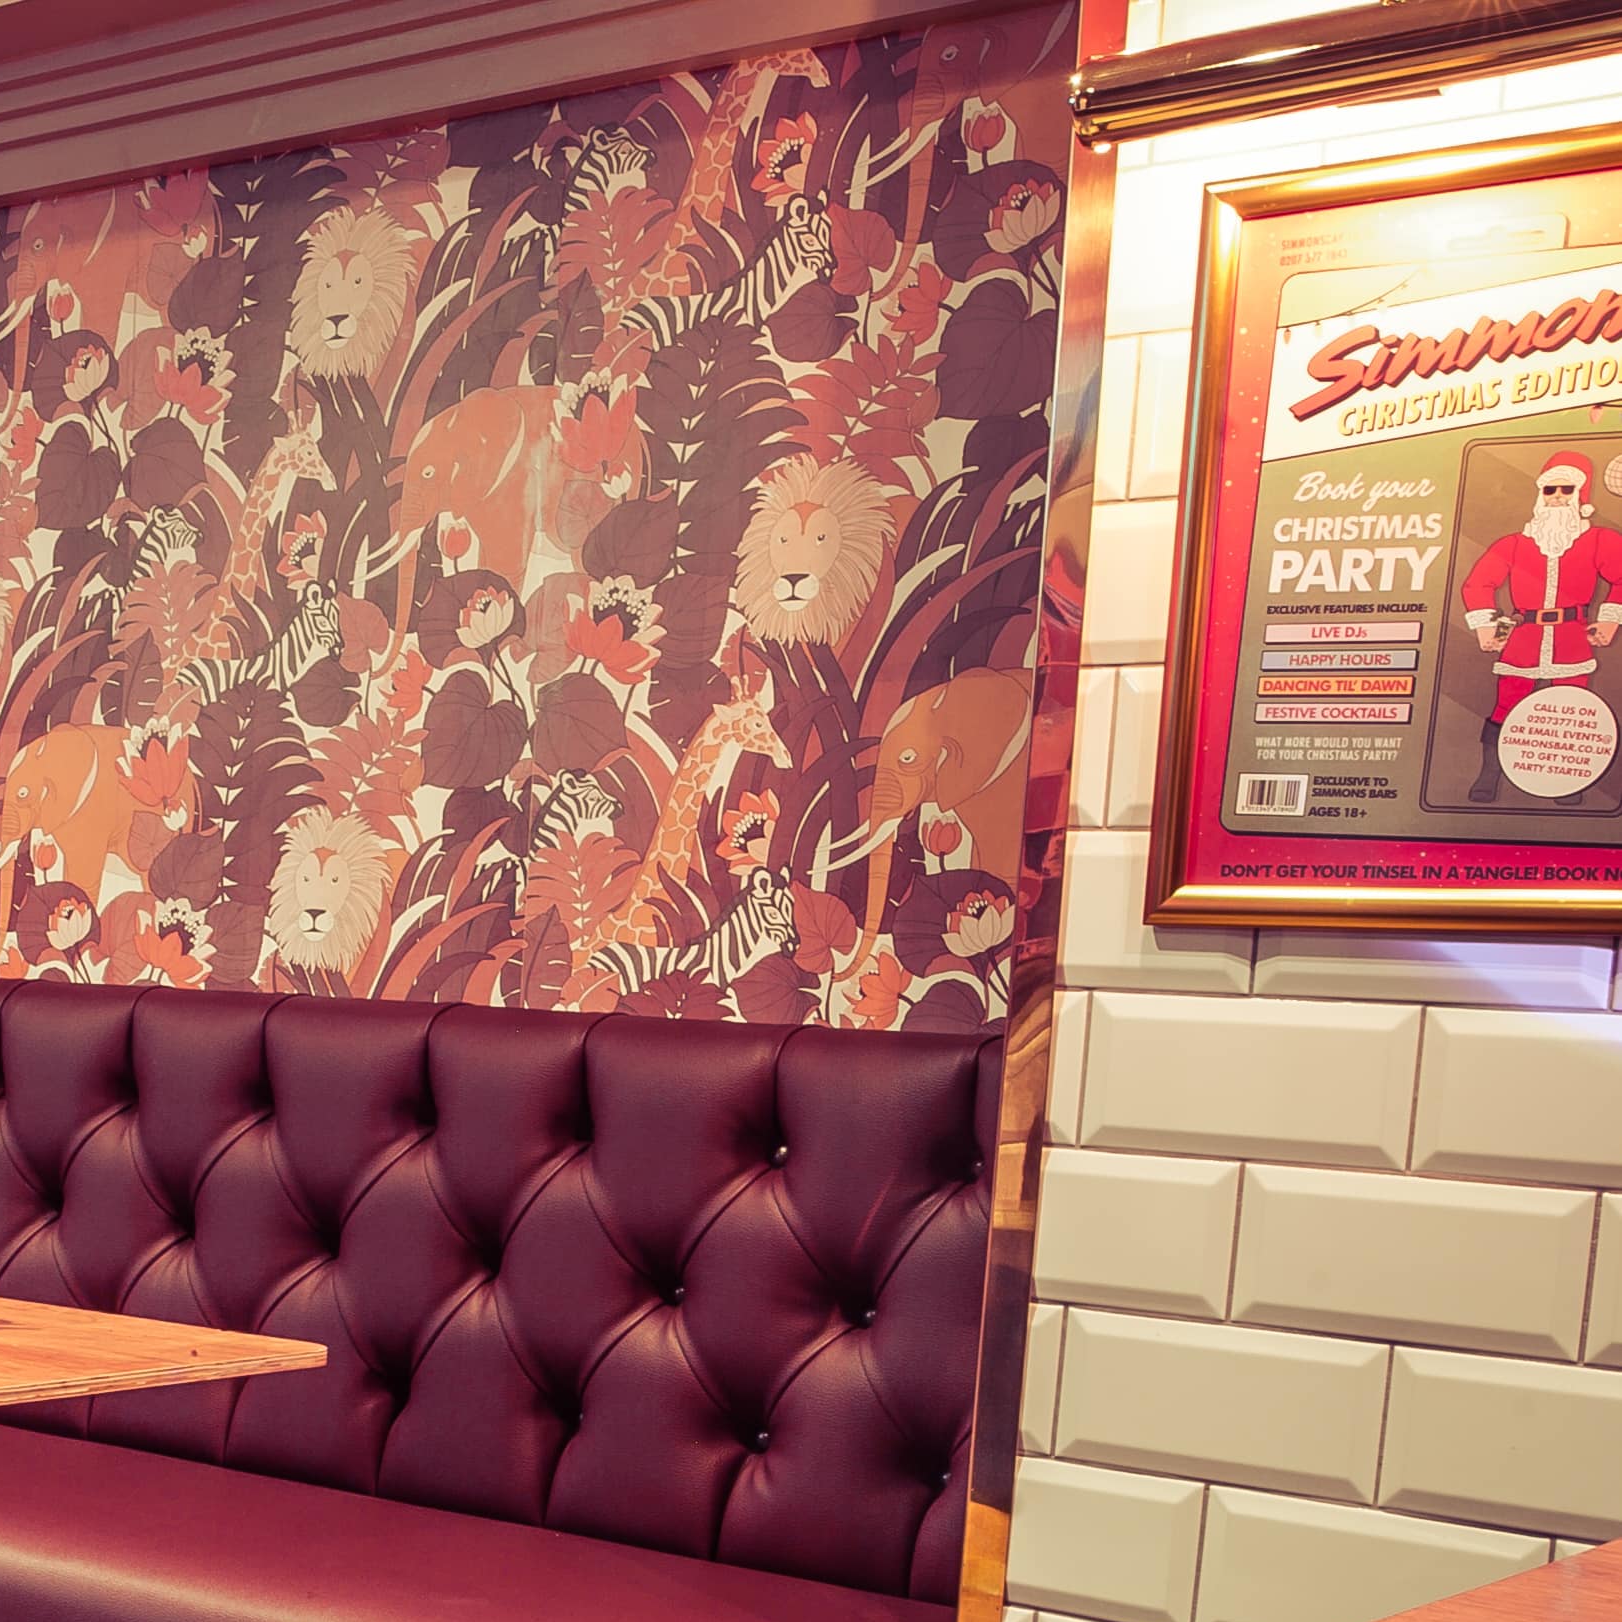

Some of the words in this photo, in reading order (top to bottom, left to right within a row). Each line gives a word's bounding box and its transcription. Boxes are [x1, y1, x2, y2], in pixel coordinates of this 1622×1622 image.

[1289, 288, 1622, 422] Simmon
[1337, 378, 1502, 436] CHRISTMAS
[1511, 358, 1622, 404] EDITIO
[1294, 471, 1365, 501] Book
[1362, 478, 1435, 512] your
[1273, 513, 1443, 543] CHRISTMAS
[1268, 546, 1443, 593] PARTY
[1267, 604, 1321, 614] EXCLUSIVE
[1323, 603, 1375, 613] FEATURES
[1377, 602, 1427, 613] INCLUDE:
[1311, 627, 1340, 638] LIVE
[1345, 626, 1368, 638] DJs
[1289, 655, 1335, 666] HAPPY
[1340, 654, 1391, 665] HOURS
[1263, 680, 1331, 692] DANCING
[1360, 680, 1407, 692] DAWN
[1265, 708, 1317, 719] FESTIVE
[1321, 707, 1397, 719] COCKTAILS
[1534, 703, 1558, 713] CALL
[1561, 706, 1575, 715] US
[1578, 707, 1597, 717] ON
[1510, 725, 1525, 734] OR
[1528, 727, 1559, 738] EMAIL
[1255, 736, 1282, 748] WHAT
[1285, 736, 1311, 748] MORE
[1314, 737, 1349, 748] WOULD
[1352, 737, 1372, 749] YOU
[1374, 737, 1402, 749] WANT
[1257, 749, 1276, 760] FOR
[1279, 749, 1304, 760] YOUR
[1306, 749, 1360, 761] CHRISTMAS
[1363, 749, 1398, 761] PARTY?
[1521, 750, 1535, 760] TO
[1538, 752, 1558, 762] GET
[1561, 755, 1591, 766] YOUR
[1513, 762, 1545, 773] PARTY
[1547, 765, 1592, 778] STARTED
[1313, 776, 1370, 787] EXCLUSIVE
[1372, 777, 1388, 787] TO
[1311, 788, 1366, 798] SIMMONS
[1368, 788, 1398, 799] BARS
[1308, 807, 1340, 818] AGES
[1344, 808, 1368, 818] 18+
[1276, 865, 1307, 878] GET
[1311, 865, 1358, 878] YOUR
[1362, 866, 1417, 879] TINSEL
[1422, 866, 1442, 879] IN
[1446, 866, 1459, 879] A
[1465, 866, 1539, 880] TANGLE!
[1544, 867, 1599, 881] BOOK
